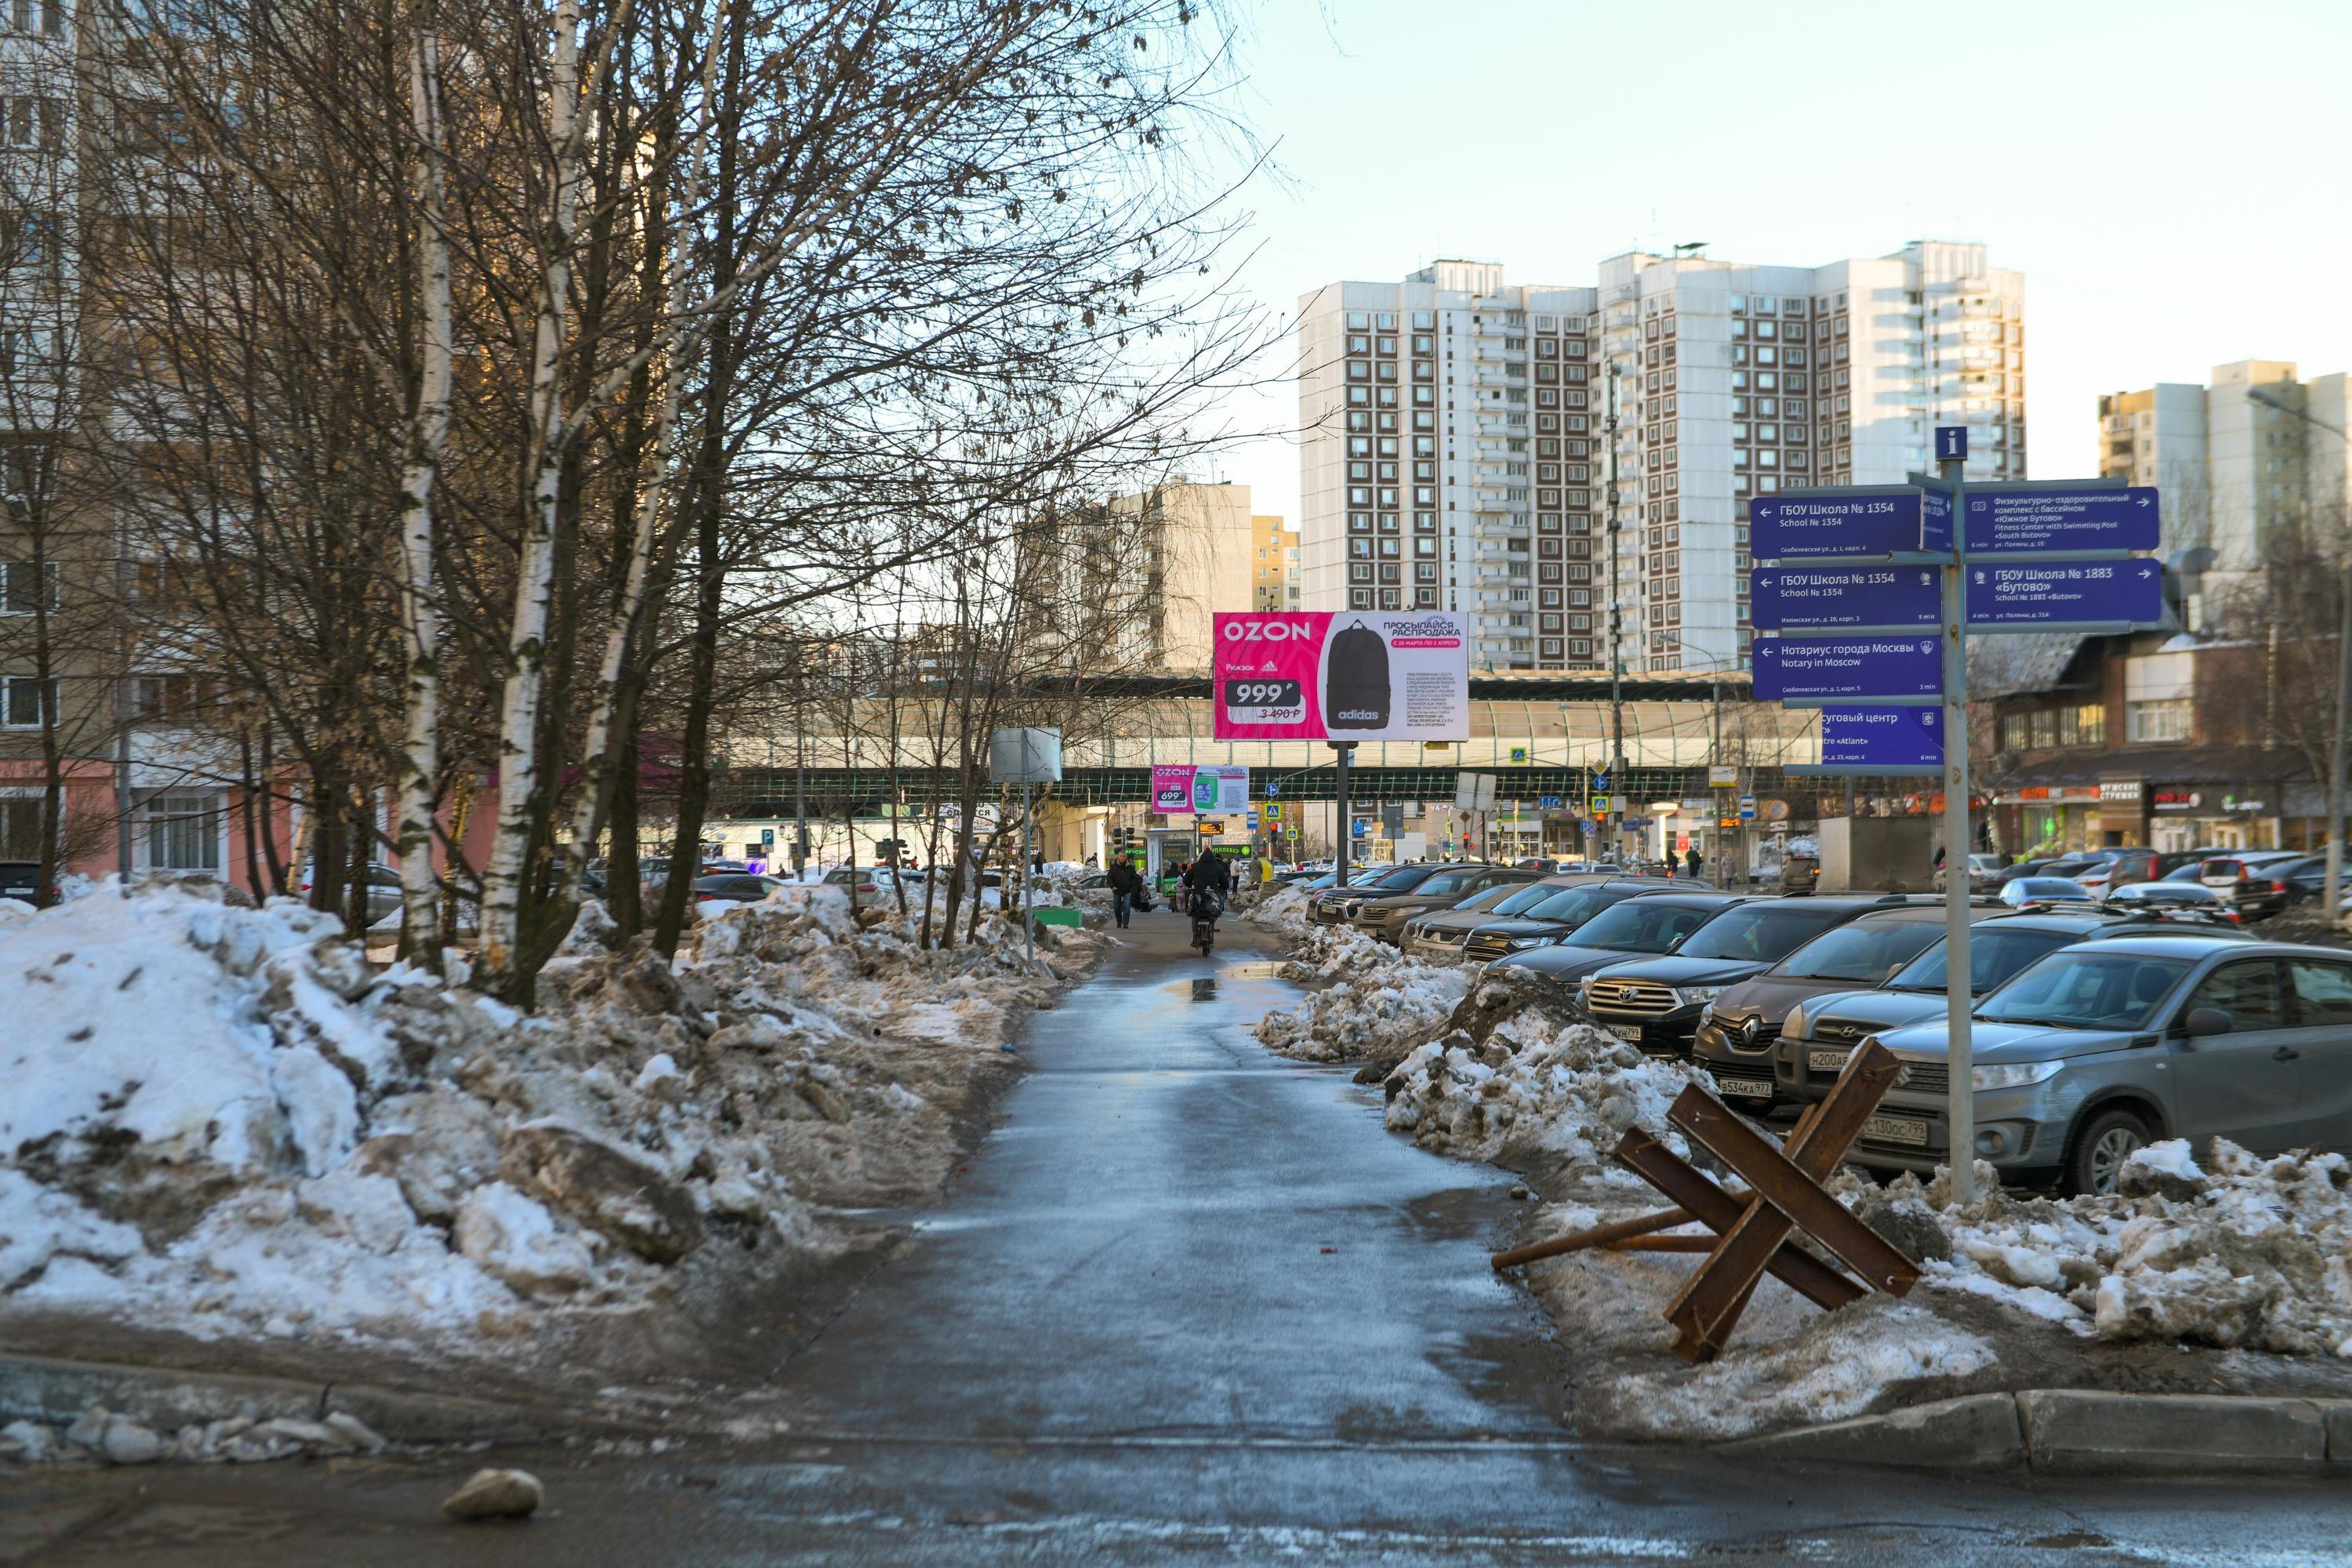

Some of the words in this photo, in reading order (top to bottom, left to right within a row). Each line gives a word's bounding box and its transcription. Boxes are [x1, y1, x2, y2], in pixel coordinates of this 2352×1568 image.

[1994, 495, 2129, 506] Физкультурно-оздоровительный
[1780, 506, 1807, 516] ГБОУ
[1809, 504, 1848, 515] Школа
[1851, 504, 1864, 514] №
[1867, 503, 1894, 513] 1354
[2063, 522, 2100, 531] Swimming
[1995, 571, 2024, 580] ГБОУ
[2026, 569, 2064, 580] Школа
[2067, 569, 2081, 579] №
[2085, 568, 2112, 579] 1883
[1780, 576, 1808, 586] ГБОУ
[1809, 575, 1849, 585] Школа
[1852, 575, 1864, 583] №
[1867, 574, 1894, 583] 1354
[1780, 589, 1808, 597] School
[1995, 583, 2051, 593] «Бутово»
[1384, 619, 1454, 630] ПРОСЫПАЙСЯ
[1224, 622, 1310, 641] OZON
[1782, 645, 1831, 656] Нотариус
[1833, 645, 1870, 655] города
[1872, 644, 1914, 654] Москвы
[1782, 659, 1813, 669] Notary
[1825, 658, 1860, 666] Moscow
[1236, 684, 1282, 703] 999
[1261, 710, 1267, 718] 3
[1270, 710, 1290, 718] 490
[1338, 709, 1380, 720] adidas
[1866, 714, 1897, 724] центр
[1156, 768, 1189, 777] OZON
[1161, 792, 1179, 800] 699
[1628, 1027, 1639, 1036] 799
[1722, 1081, 1754, 1094] В534КА
[1756, 1083, 1769, 1092] 977
[1866, 1119, 1905, 1136] С130ОС
[1907, 1122, 1925, 1134] 799
